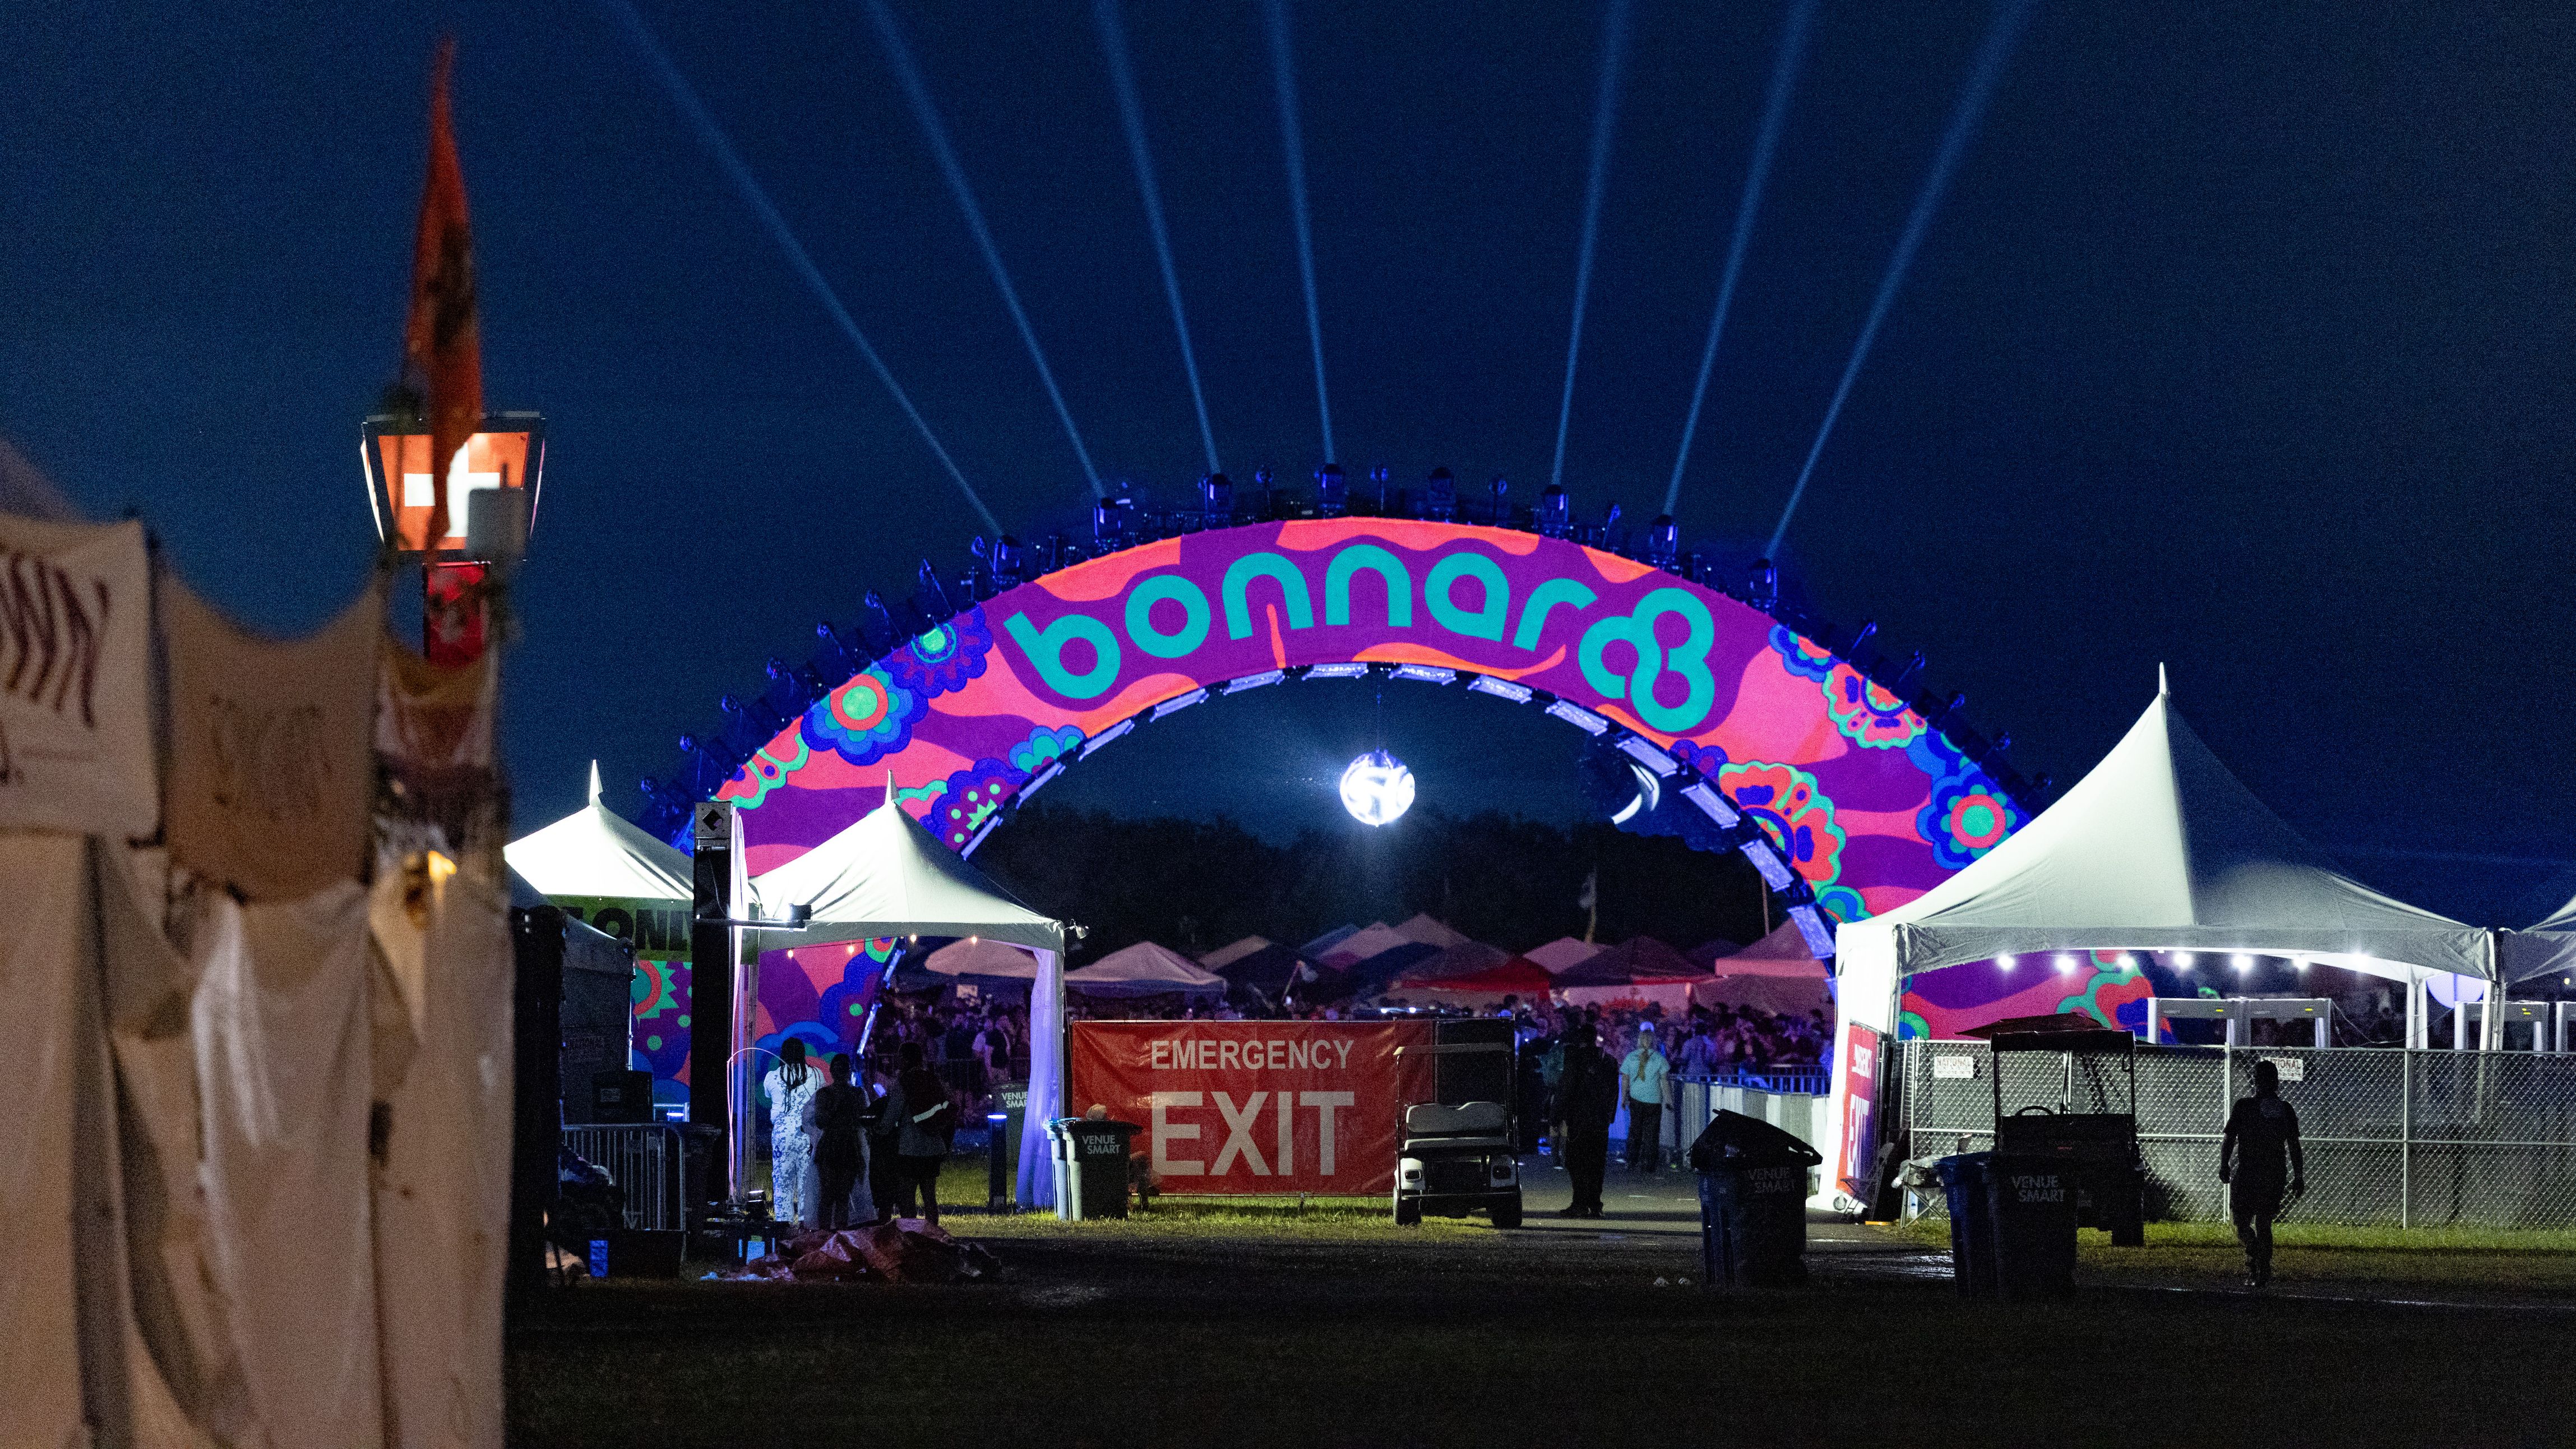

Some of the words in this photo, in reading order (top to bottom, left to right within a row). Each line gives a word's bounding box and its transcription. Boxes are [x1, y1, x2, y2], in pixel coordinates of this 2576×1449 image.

[1151, 1040, 1354, 1070] EMERGENCY
[1006, 1100, 1027, 1108] SMA
[1081, 1134, 1115, 1144] VENUE
[1151, 1091, 1354, 1175] EXIT
[1088, 1145, 1120, 1154] SMART
[1747, 1166, 1791, 1180] VENUE
[2010, 1175, 2058, 1188] VENUE
[2018, 1189, 2065, 1202] SMART
